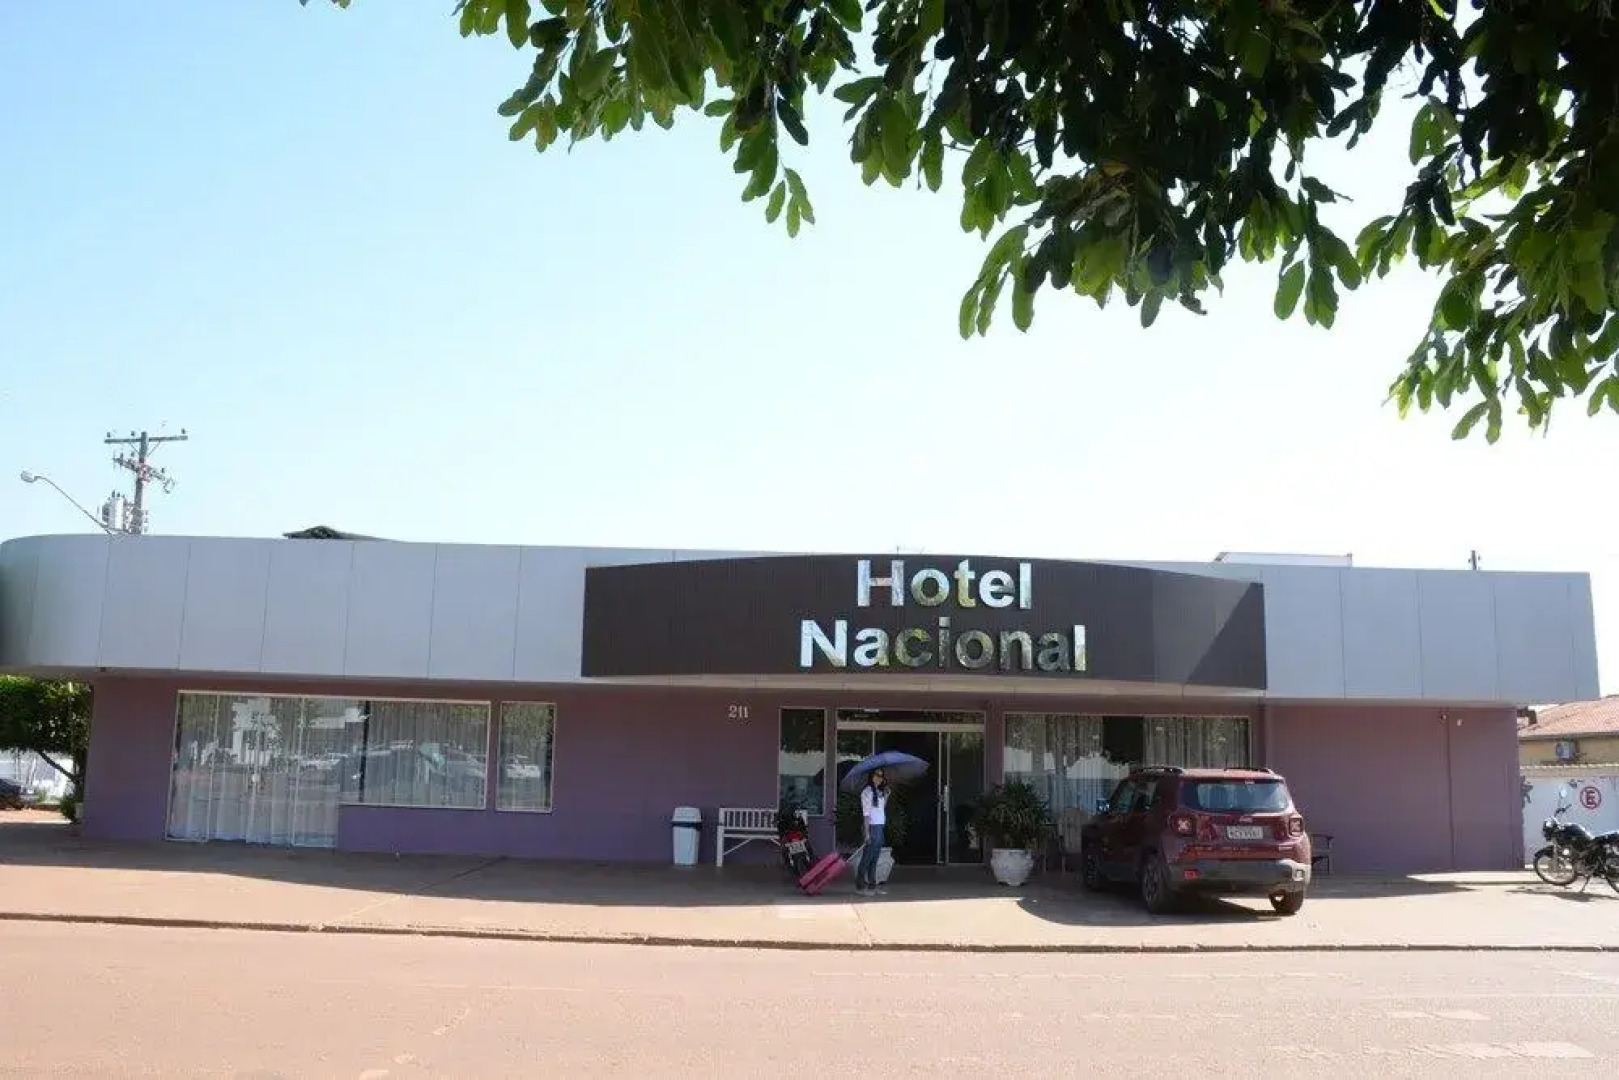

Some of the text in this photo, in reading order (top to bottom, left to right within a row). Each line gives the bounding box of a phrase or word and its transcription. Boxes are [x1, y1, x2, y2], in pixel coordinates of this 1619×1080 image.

[857, 559, 1032, 609] Hotel
[800, 616, 1087, 672] Nacional
[728, 705, 749, 718] 211
